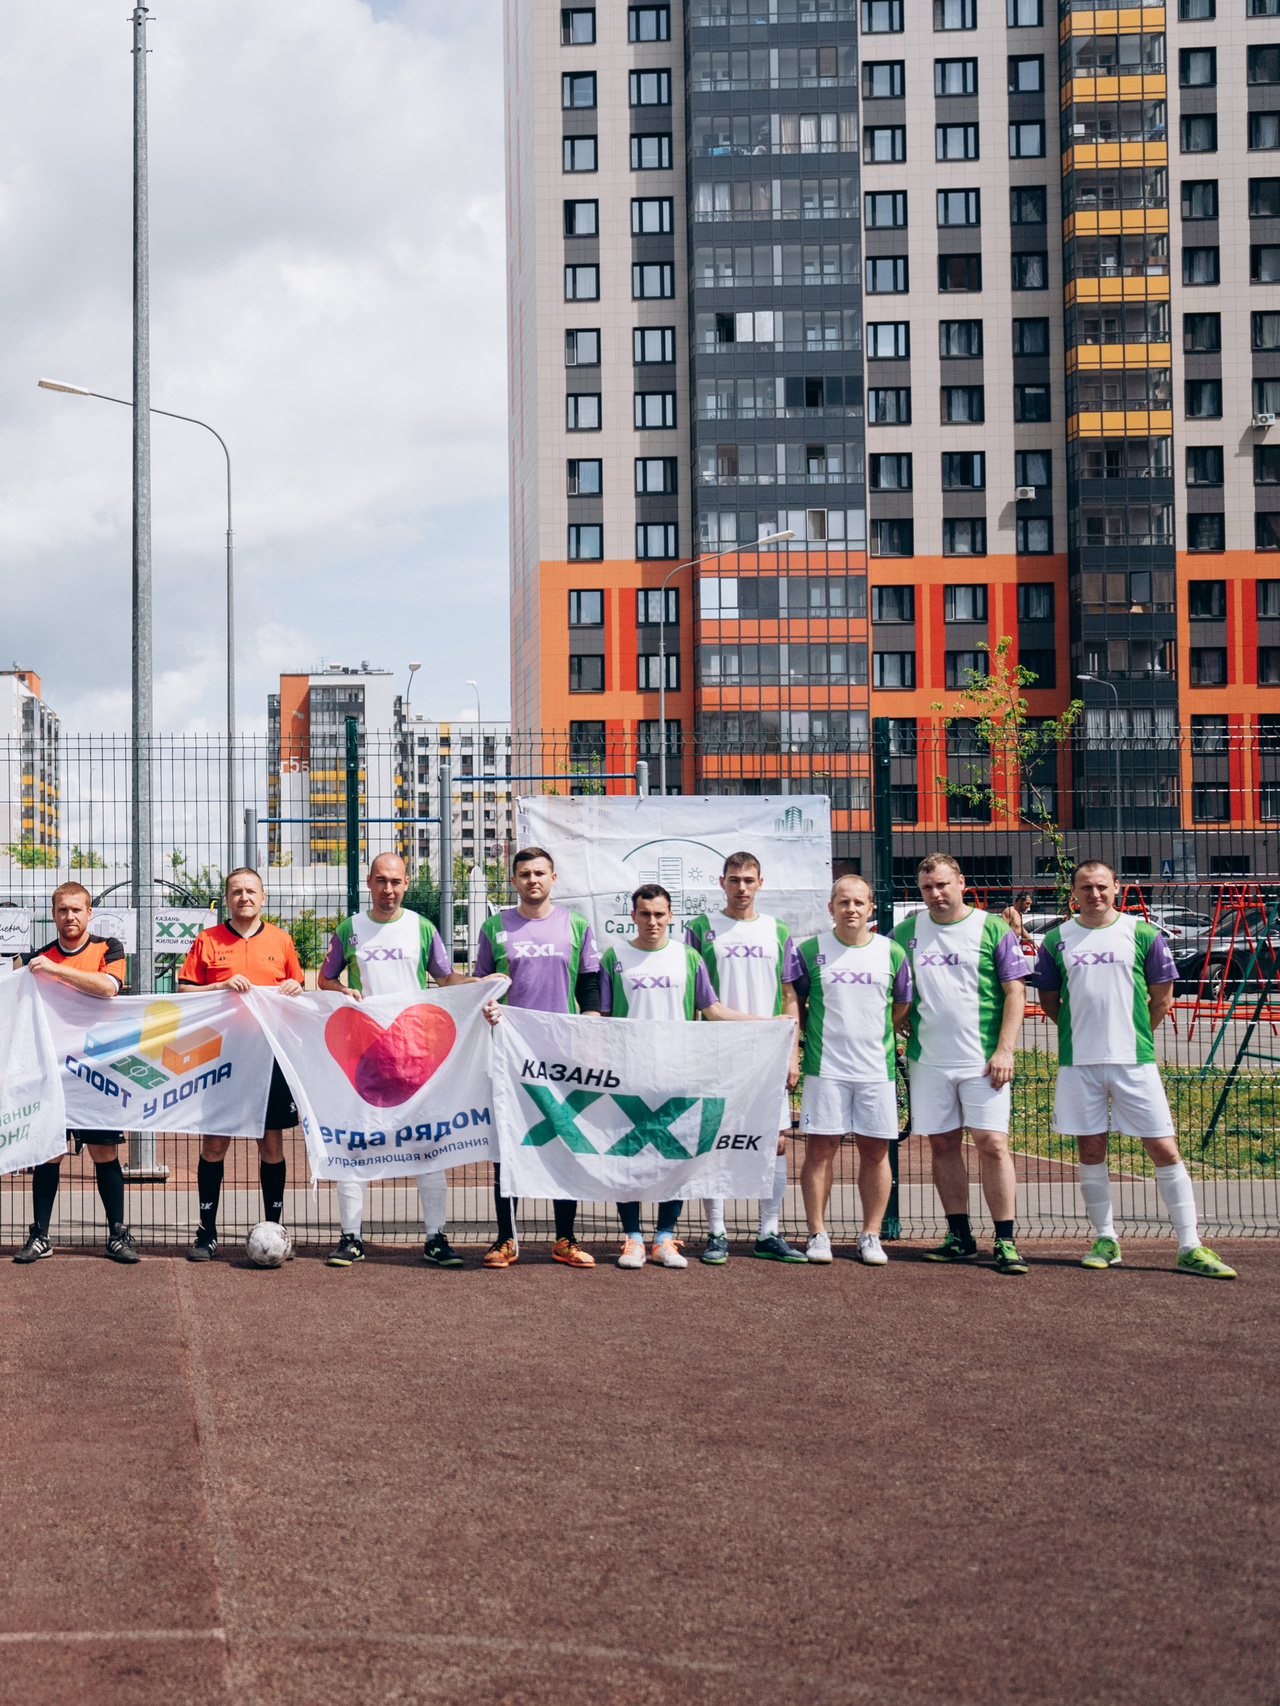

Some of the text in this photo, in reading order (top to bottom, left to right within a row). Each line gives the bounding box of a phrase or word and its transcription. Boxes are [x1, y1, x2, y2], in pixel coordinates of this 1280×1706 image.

[349, 935, 358, 945] 10
[706, 933, 714, 941] 4
[513, 944, 554, 958] XXI
[908, 940, 916, 949] 2
[364, 948, 403, 961] XXI
[724, 946, 763, 958] XXI
[817, 956, 824, 964] 5
[920, 953, 959, 966] XXI
[1071, 952, 1114, 966] XXI
[630, 976, 670, 990] XXI
[830, 972, 871, 984] XXI
[521, 1059, 620, 1088] КАЗАНЬ
[65, 1055, 132, 1108] СПОРТ
[395, 1107, 491, 1147] рядом
[520, 1082, 762, 1160] XXI ВЕК
[327, 1136, 489, 1168] управляющая компания
